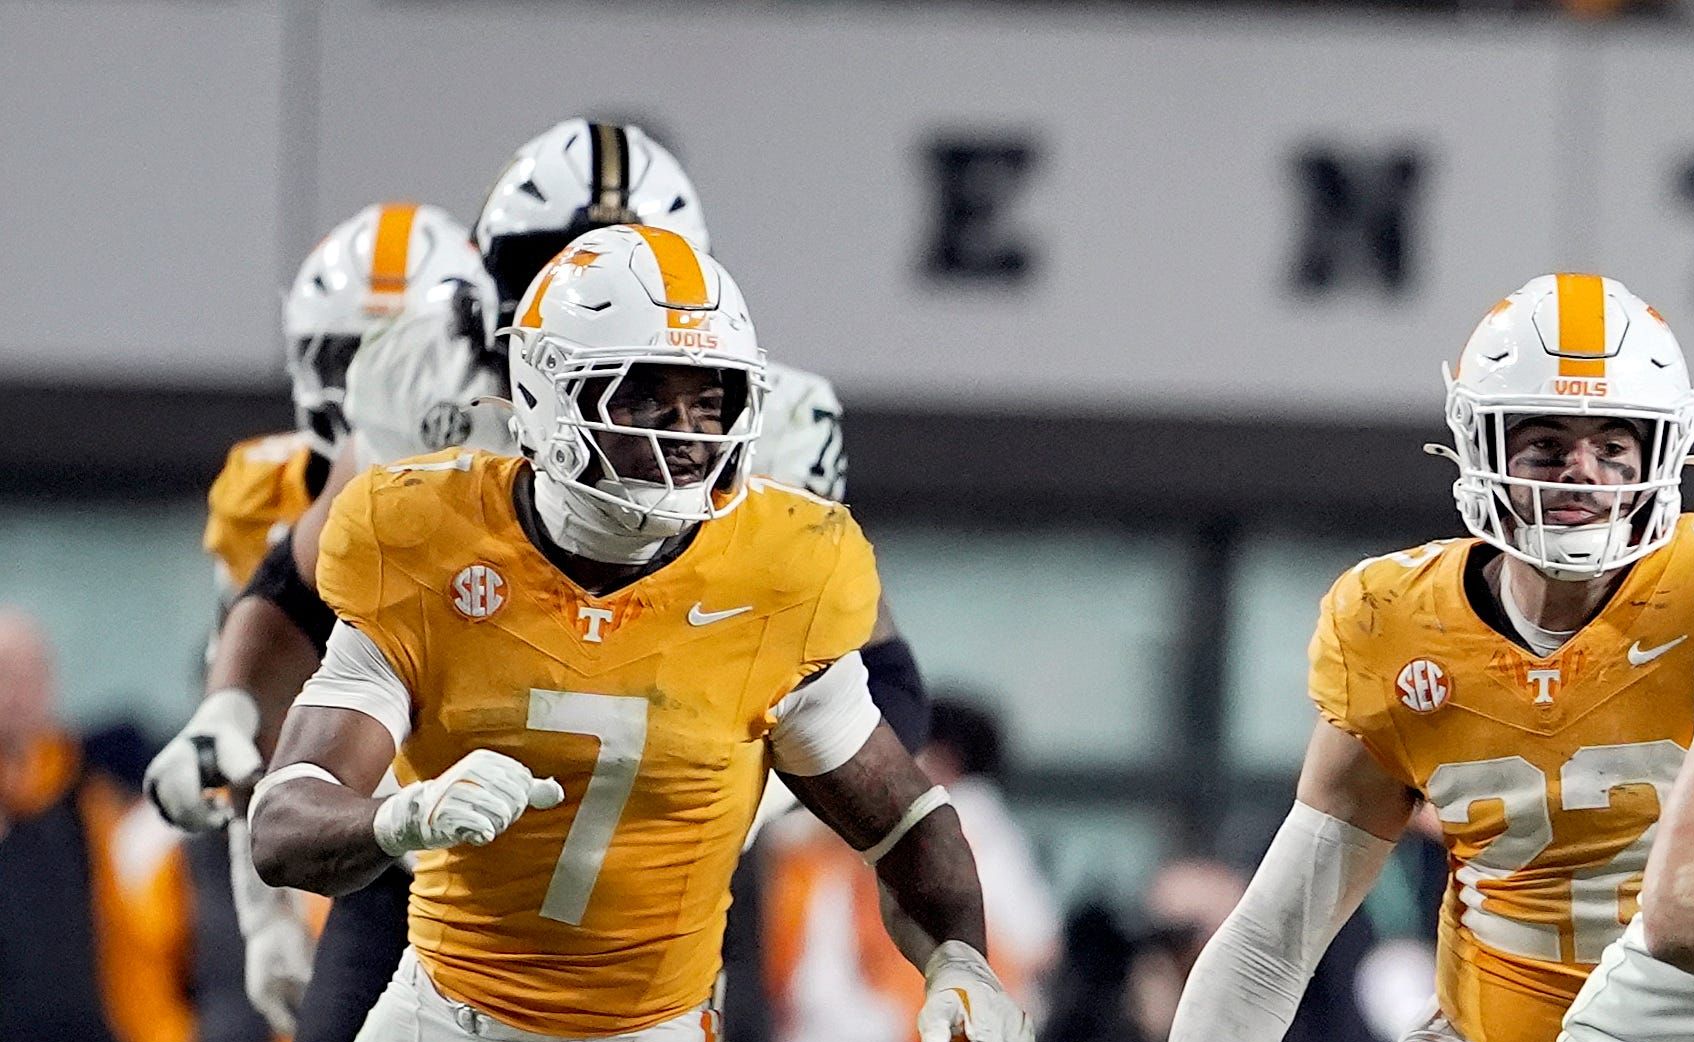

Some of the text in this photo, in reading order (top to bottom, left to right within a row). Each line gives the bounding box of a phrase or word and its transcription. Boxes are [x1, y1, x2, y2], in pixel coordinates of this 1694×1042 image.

[669, 331, 719, 349] VOLS
[1554, 379, 1608, 397] VOLS
[453, 565, 504, 618] SEC
[578, 607, 614, 643] T
[1397, 660, 1447, 712] SEC
[1527, 669, 1562, 705] T
[526, 687, 650, 926] 7
[1428, 738, 1691, 964] 22
